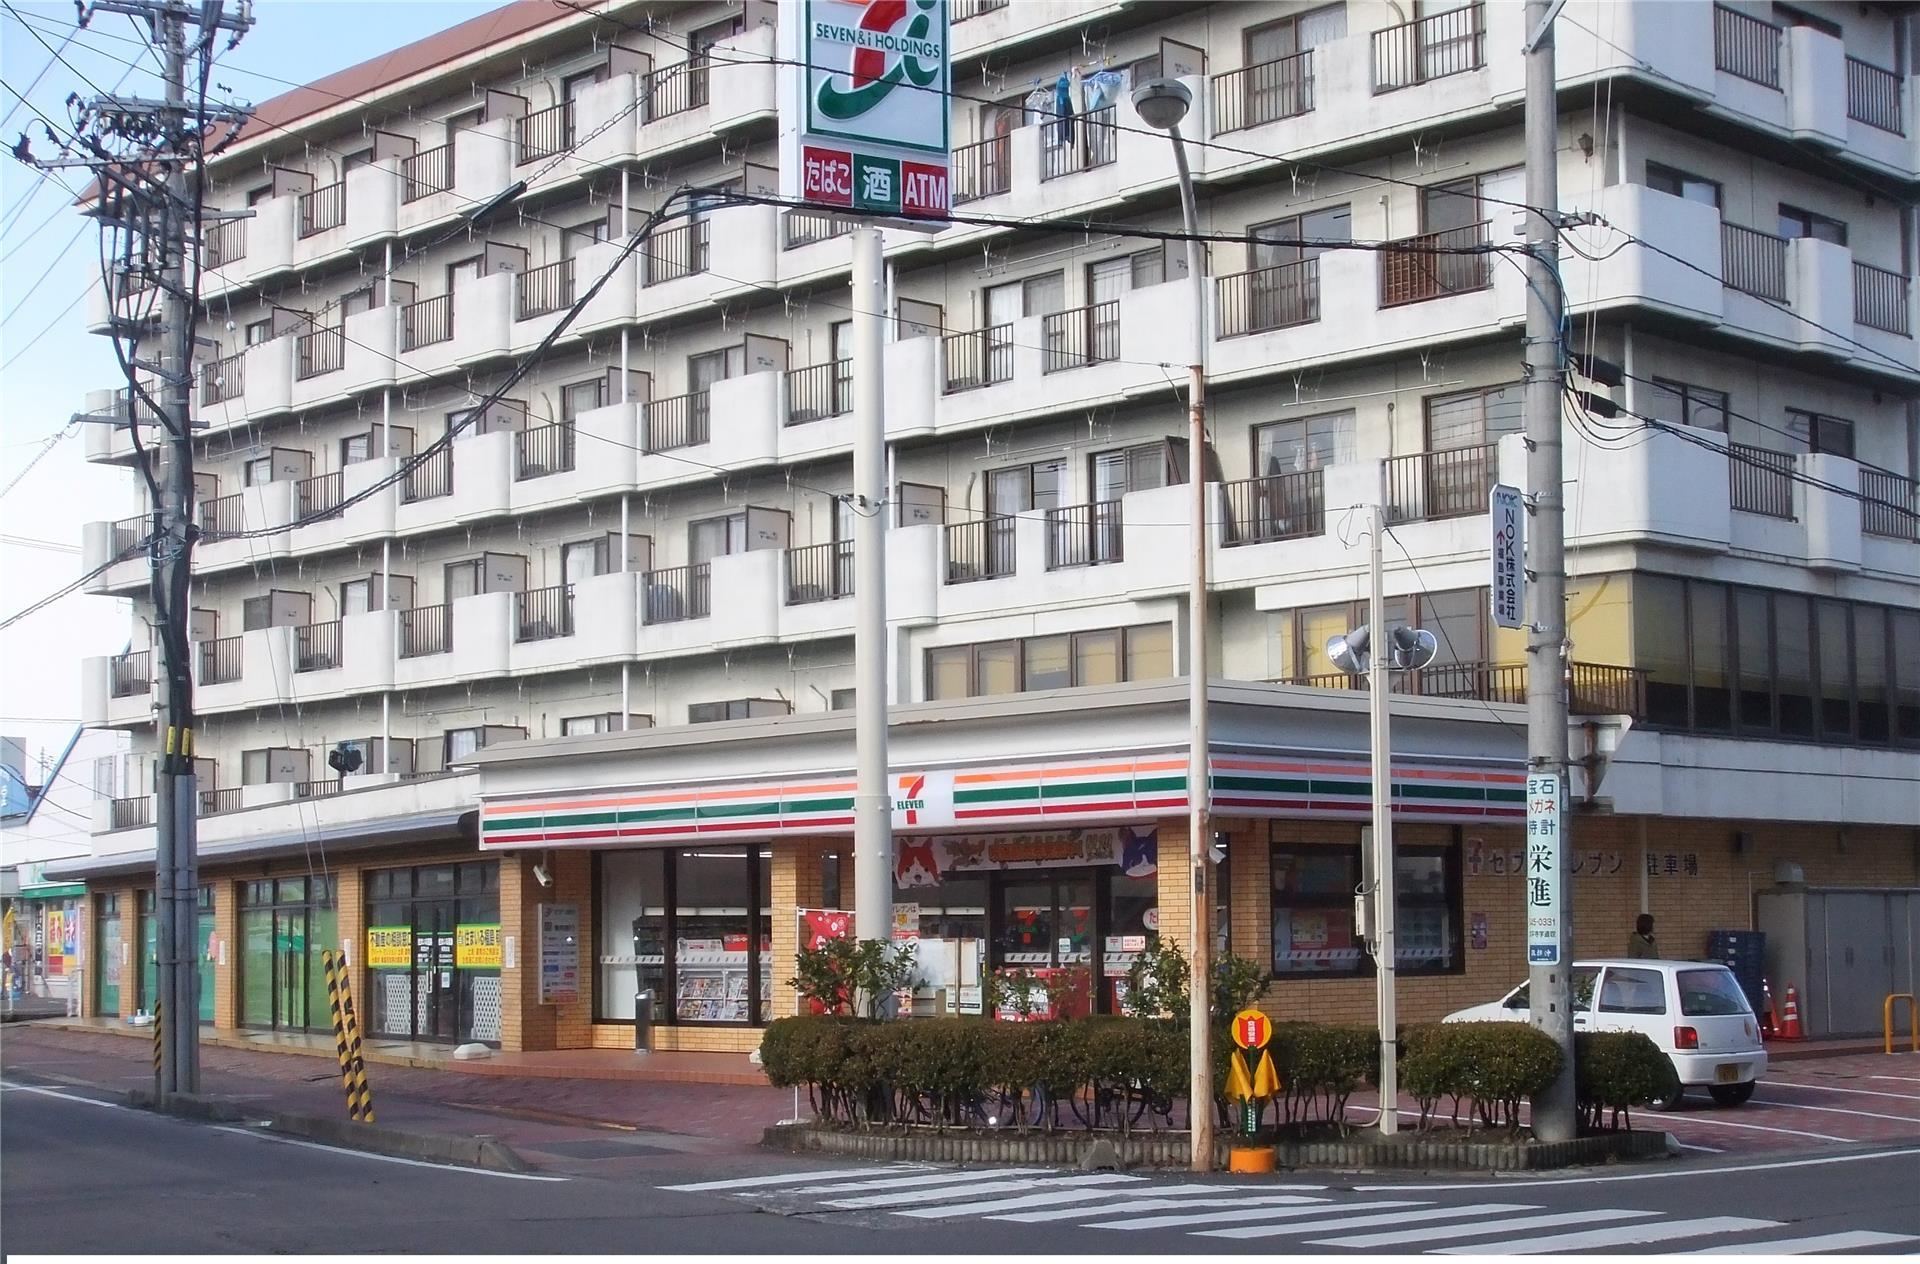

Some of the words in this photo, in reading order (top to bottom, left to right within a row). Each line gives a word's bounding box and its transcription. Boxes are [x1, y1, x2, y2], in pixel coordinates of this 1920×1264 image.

[875, 35, 940, 58] HOLDINGS
[805, 158, 851, 195] たばこ
[862, 164, 892, 202] 酒
[904, 171, 946, 210] ATM
[1505, 508, 1517, 621] NOK株式会社
[1528, 844, 1553, 907] 栄進
